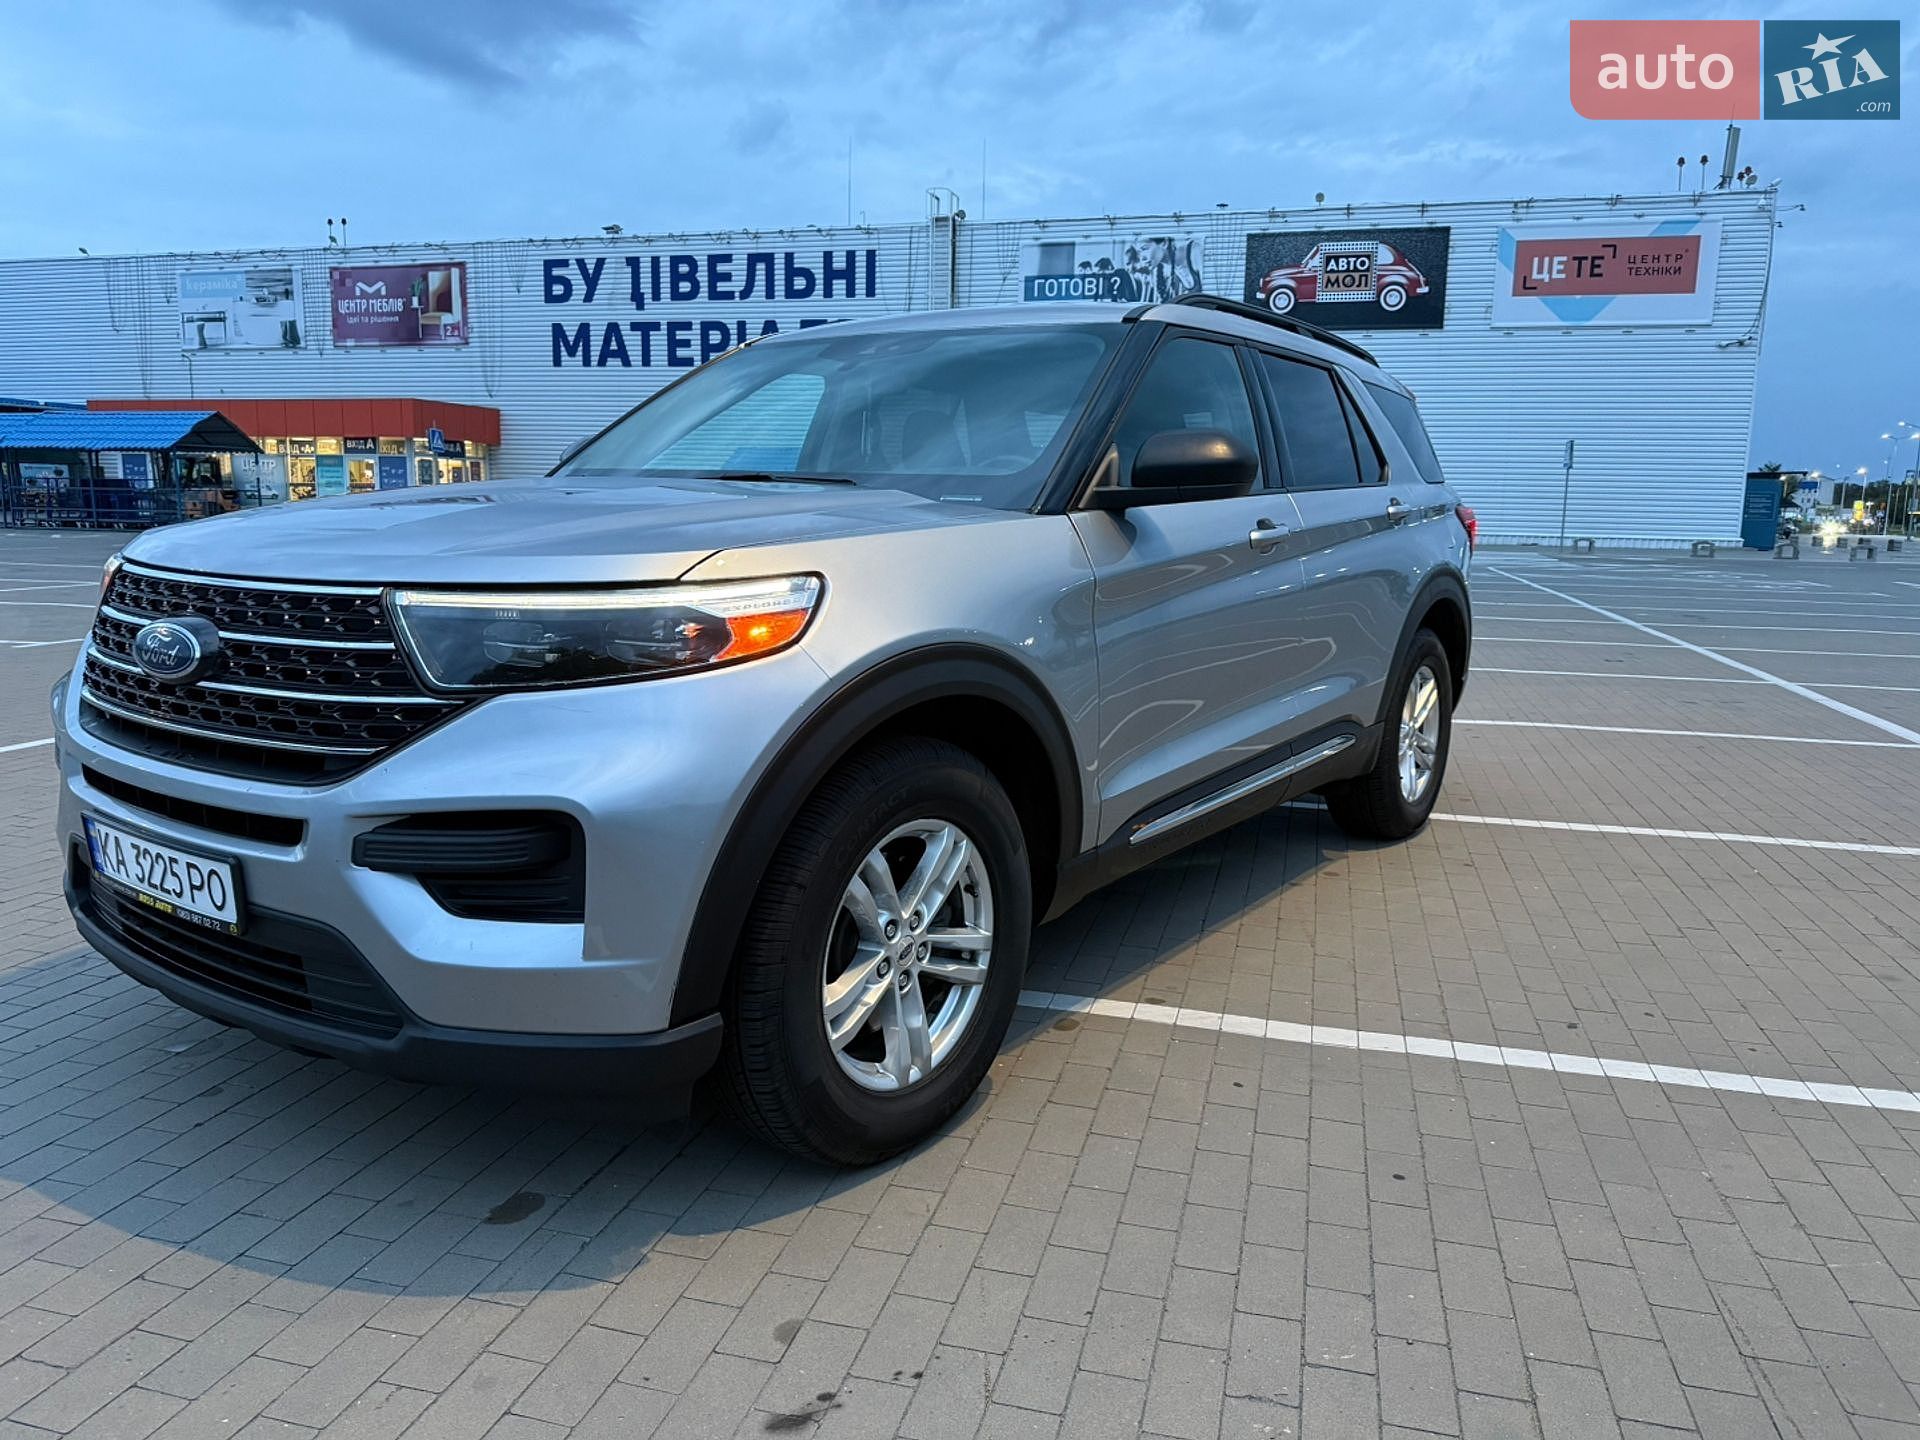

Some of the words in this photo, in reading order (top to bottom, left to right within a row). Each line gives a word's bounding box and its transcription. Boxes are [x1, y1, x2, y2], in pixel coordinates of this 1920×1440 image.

[1326, 257, 1370, 271] АВТО
[1627, 253, 1684, 265] ЦЕНТР
[1627, 266, 1682, 276] ТЕХНІКИ
[1034, 278, 1104, 297] ГОТОВІ
[1324, 274, 1369, 289] МОЛ
[338, 299, 368, 314] ЦЕНТР
[369, 298, 404, 313] МЕБЛІВ
[142, 633, 180, 666] Ford
[97, 828, 130, 878] KA
[130, 842, 183, 899] 3225
[185, 861, 227, 912] PO
